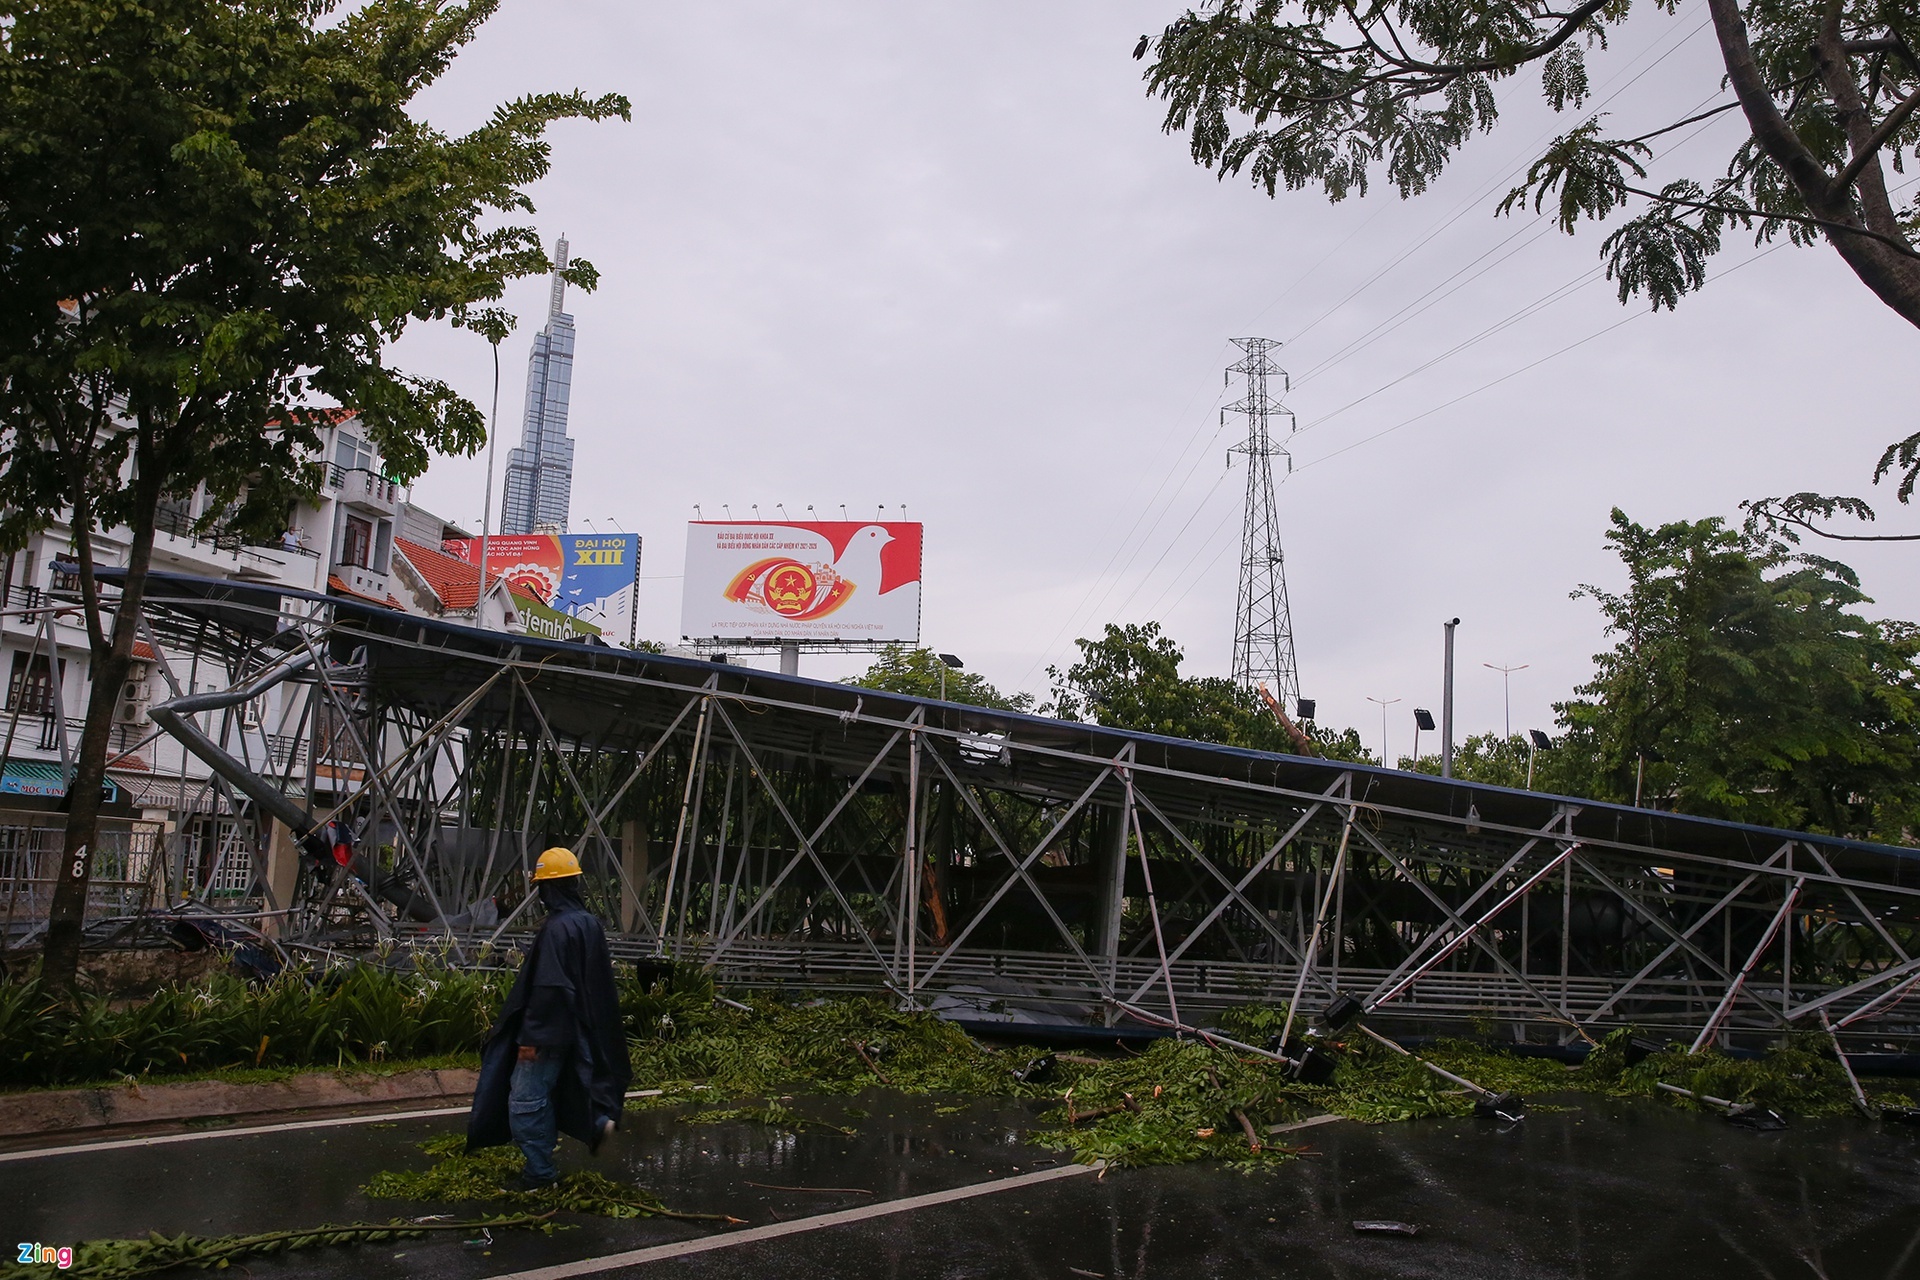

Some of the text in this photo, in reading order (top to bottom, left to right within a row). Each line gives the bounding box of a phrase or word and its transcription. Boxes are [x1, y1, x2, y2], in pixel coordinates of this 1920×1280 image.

[575, 537, 626, 551] ĐẠI HỘI
[573, 549, 625, 566] XIII
